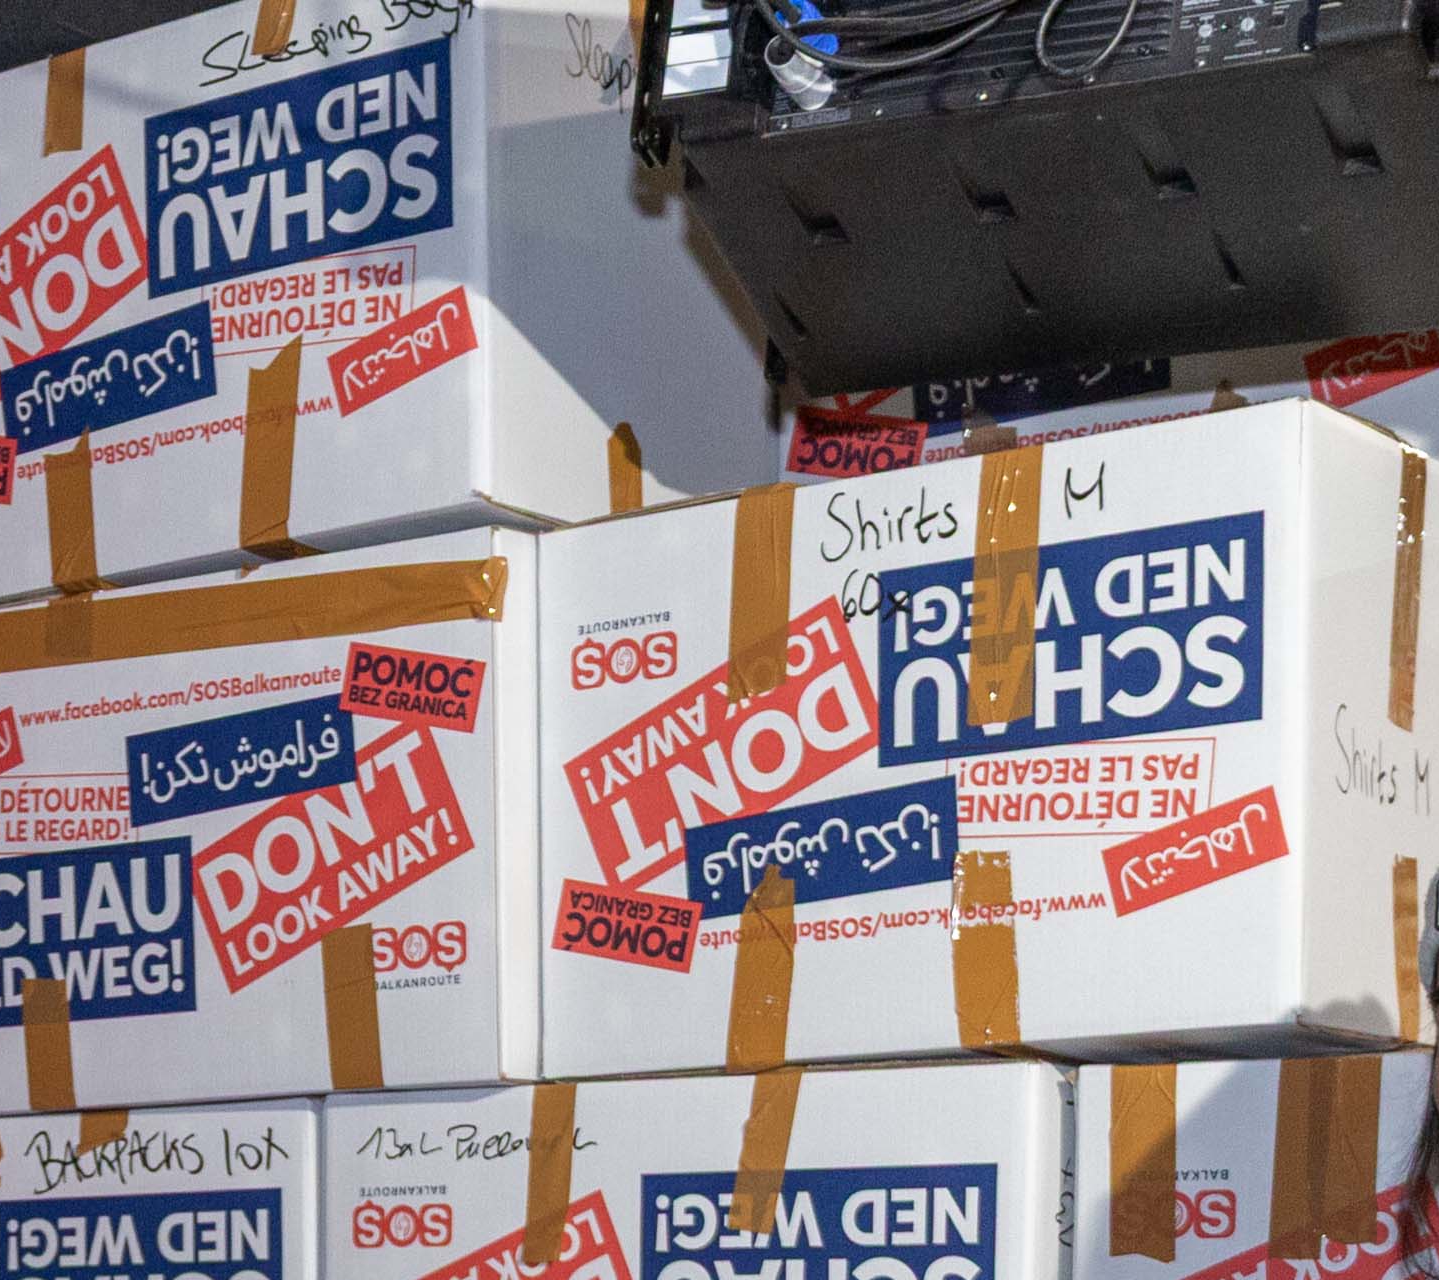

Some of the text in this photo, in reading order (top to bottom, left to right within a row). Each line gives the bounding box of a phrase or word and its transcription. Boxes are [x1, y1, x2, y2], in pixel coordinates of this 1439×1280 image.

[157, 63, 437, 191] NED WEG!
[23, 164, 115, 256] LOOK
[160, 135, 439, 279] SCHAU
[213, 262, 403, 308] PAS LE REGARD!
[821, 461, 1107, 562] Shirts M
[1095, 542, 1246, 618] NED
[352, 652, 472, 698] POMOĆ
[571, 631, 677, 691] SOS
[21, 665, 341, 728] www.facebook.com/SOSBalkanroute
[349, 685, 468, 720] BEZ GRANICA
[585, 696, 709, 806] AWAY!
[959, 754, 1199, 783] PAS LE REGARD!
[1335, 703, 1397, 805] Shirts
[1, 777, 130, 813] DÉTOURNE
[957, 788, 1196, 828] NE DÉTOURNE
[7, 820, 28, 843] LE
[34, 817, 131, 842] REGARD!
[225, 809, 456, 978] LOOK AWAY!
[571, 889, 693, 926] BEZ GRANICA
[51, 941, 184, 1003] WEG!
[562, 922, 688, 962] POMOĆ
[359, 1185, 447, 1197] BALKANROUTE
[655, 1187, 979, 1253] NED WEG!
[6, 1208, 269, 1272] NED WEG!
[353, 1200, 453, 1248] SOS
